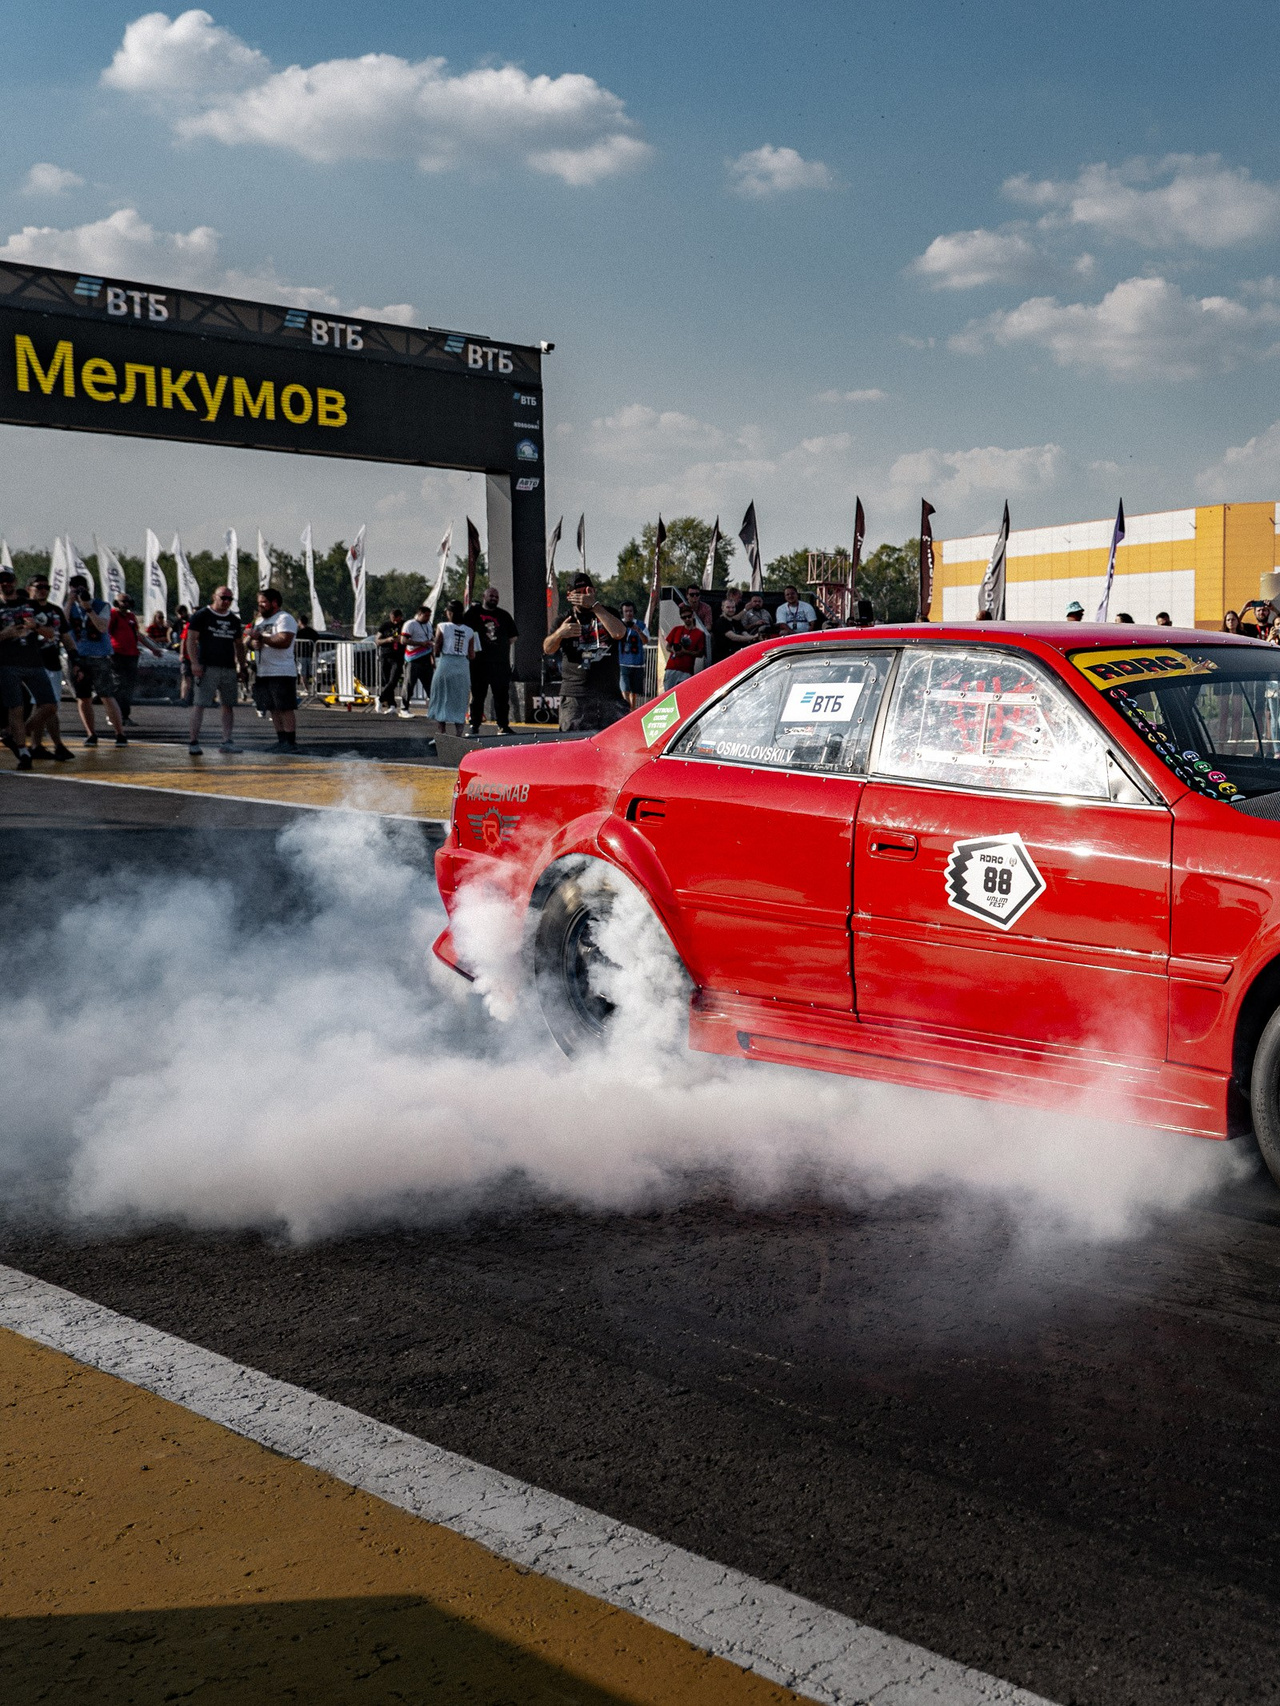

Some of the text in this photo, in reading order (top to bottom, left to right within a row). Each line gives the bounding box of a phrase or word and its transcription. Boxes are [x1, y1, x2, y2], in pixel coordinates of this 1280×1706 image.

[107, 287, 169, 322] ВТБ
[311, 319, 364, 351] ВТБ
[467, 344, 514, 374] ВТБ
[14, 333, 348, 428] Мелкумов
[520, 395, 537, 406] ВТБ
[1083, 655, 1187, 681] RDRC
[811, 695, 845, 713] ВТБ
[467, 783, 530, 803] RACESNAB
[979, 854, 1004, 864] RDRC
[983, 866, 1013, 896] 88
